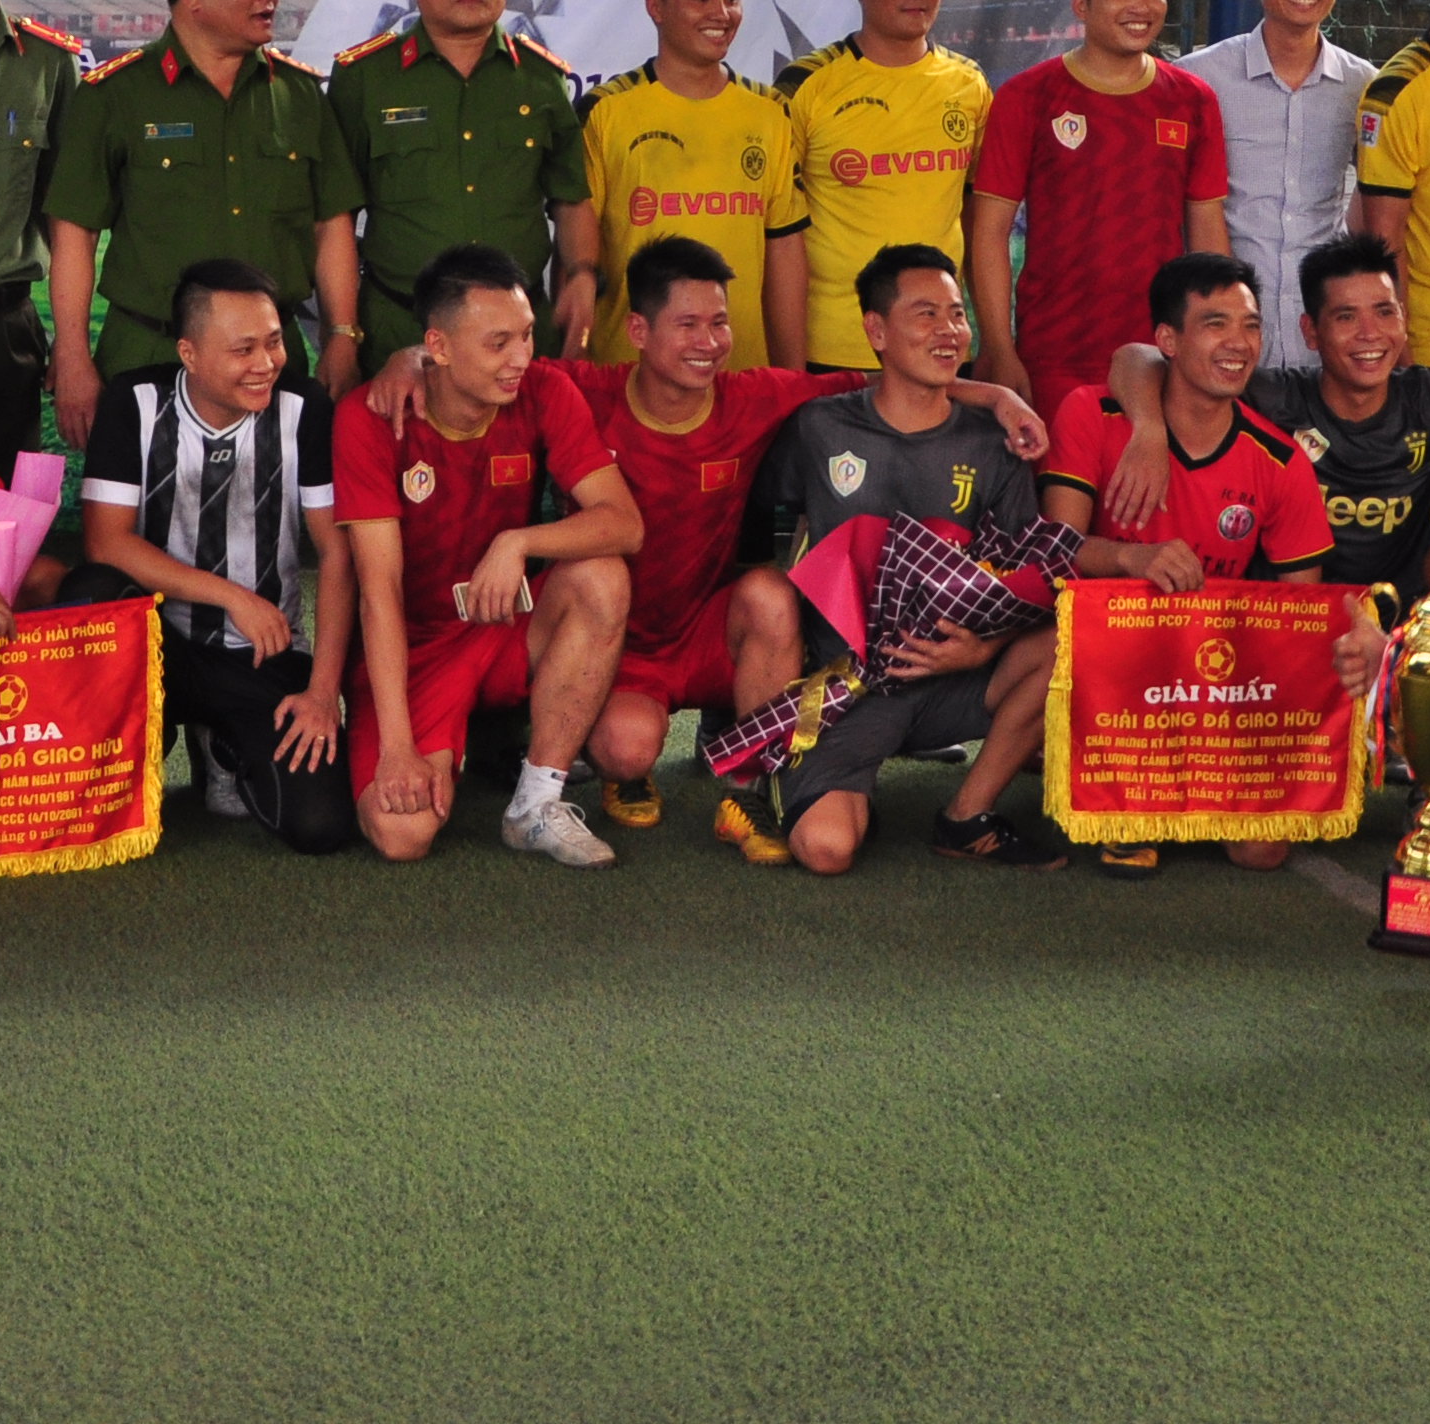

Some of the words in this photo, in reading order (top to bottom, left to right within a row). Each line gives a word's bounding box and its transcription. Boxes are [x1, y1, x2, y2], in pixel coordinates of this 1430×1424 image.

[1108, 595, 1147, 610] CÔNG
[1151, 597, 1170, 609] AN
[1174, 595, 1221, 611] THÀNH
[72, 621, 116, 638] PHÒNG
[1108, 613, 1155, 628] PHÒNG
[1158, 615, 1192, 627] PC07
[1204, 617, 1236, 629] PC09
[1245, 616, 1281, 629] PX03
[1293, 620, 1328, 632] PX05
[40, 646, 74, 661] PX03
[84, 640, 117, 655] PX05
[1144, 678, 1200, 704] GIẢI
[1207, 675, 1277, 703] NHẤT
[1095, 708, 1138, 729] GIẢI
[1143, 710, 1197, 729] BÓNG
[1236, 712, 1278, 729] GIAO
[23, 722, 64, 743] BA
[33, 745, 86, 766] GIAO
